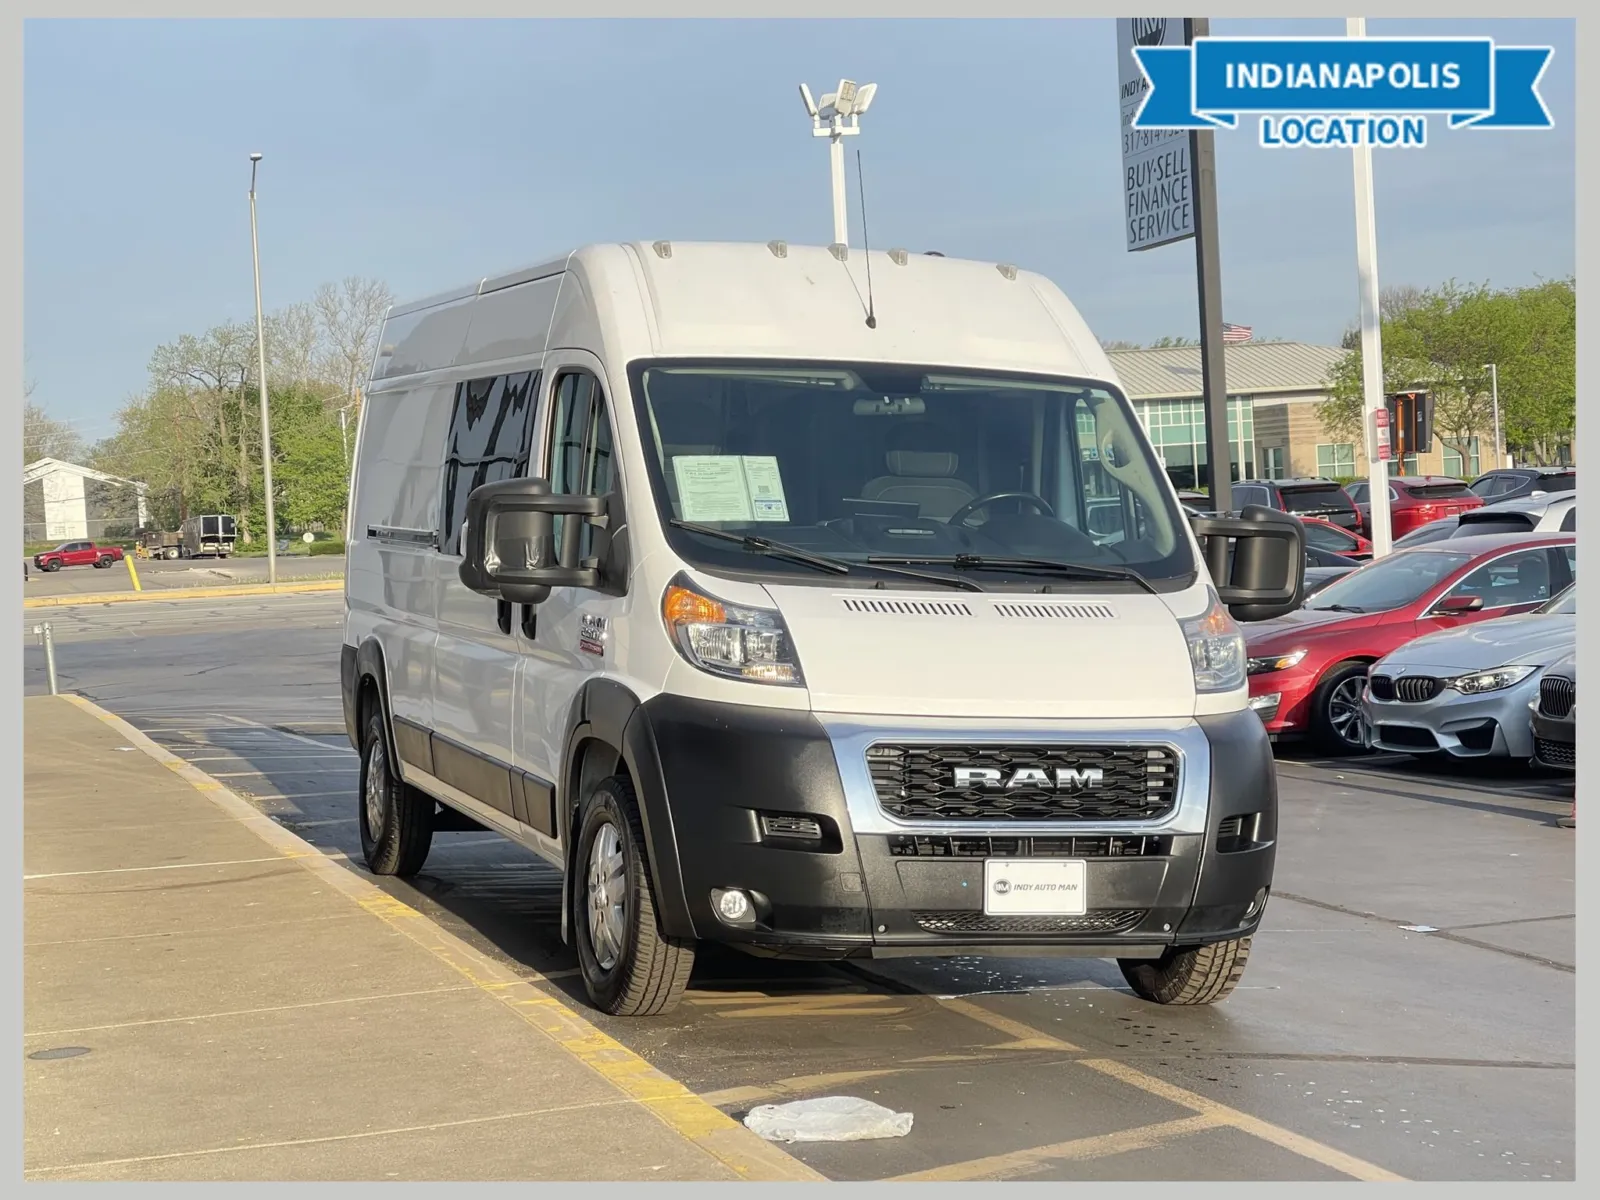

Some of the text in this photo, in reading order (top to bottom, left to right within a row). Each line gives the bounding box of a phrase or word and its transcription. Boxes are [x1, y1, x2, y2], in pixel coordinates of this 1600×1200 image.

[1121, 78, 1141, 99] INDY
[1128, 175, 1188, 218] FINANCE
[1130, 203, 1190, 244] SERVICE
[954, 767, 1104, 788] RAM
